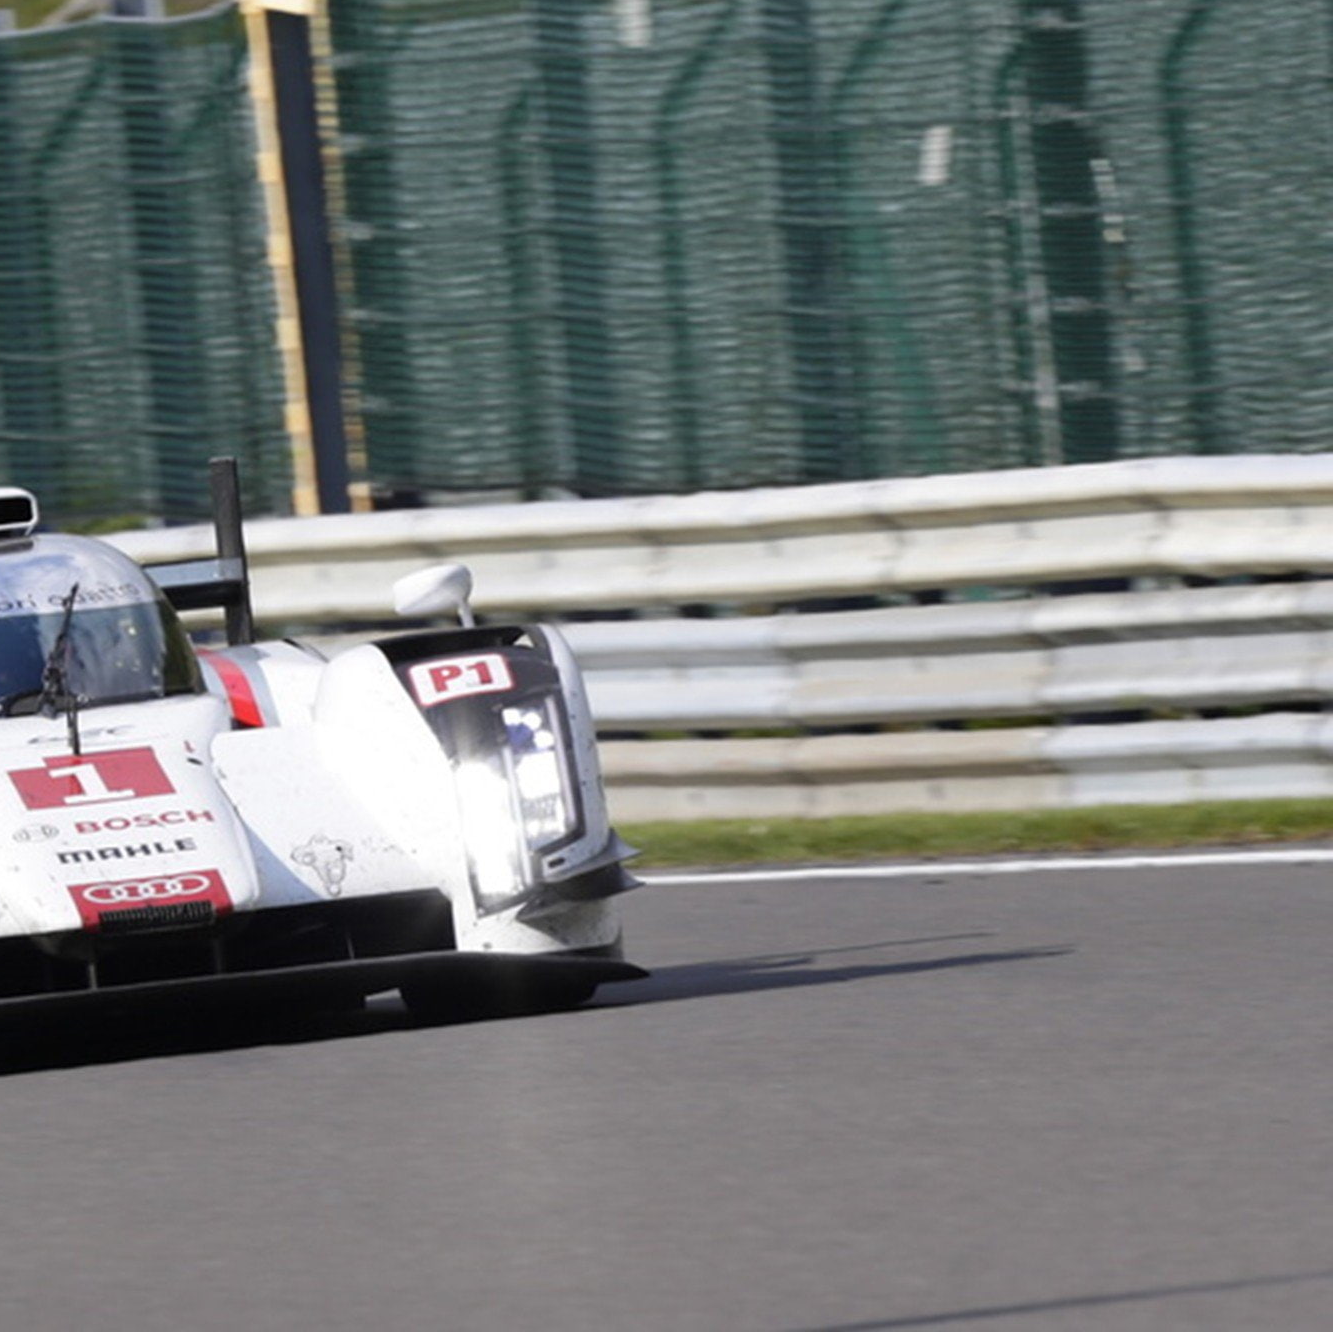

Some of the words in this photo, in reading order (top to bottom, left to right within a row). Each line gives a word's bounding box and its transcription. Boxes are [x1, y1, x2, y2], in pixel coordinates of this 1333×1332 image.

[428, 659, 493, 693] P1
[48, 763, 135, 805] 1
[74, 810, 214, 834] BOSCH
[57, 837, 197, 864] MAHLE
